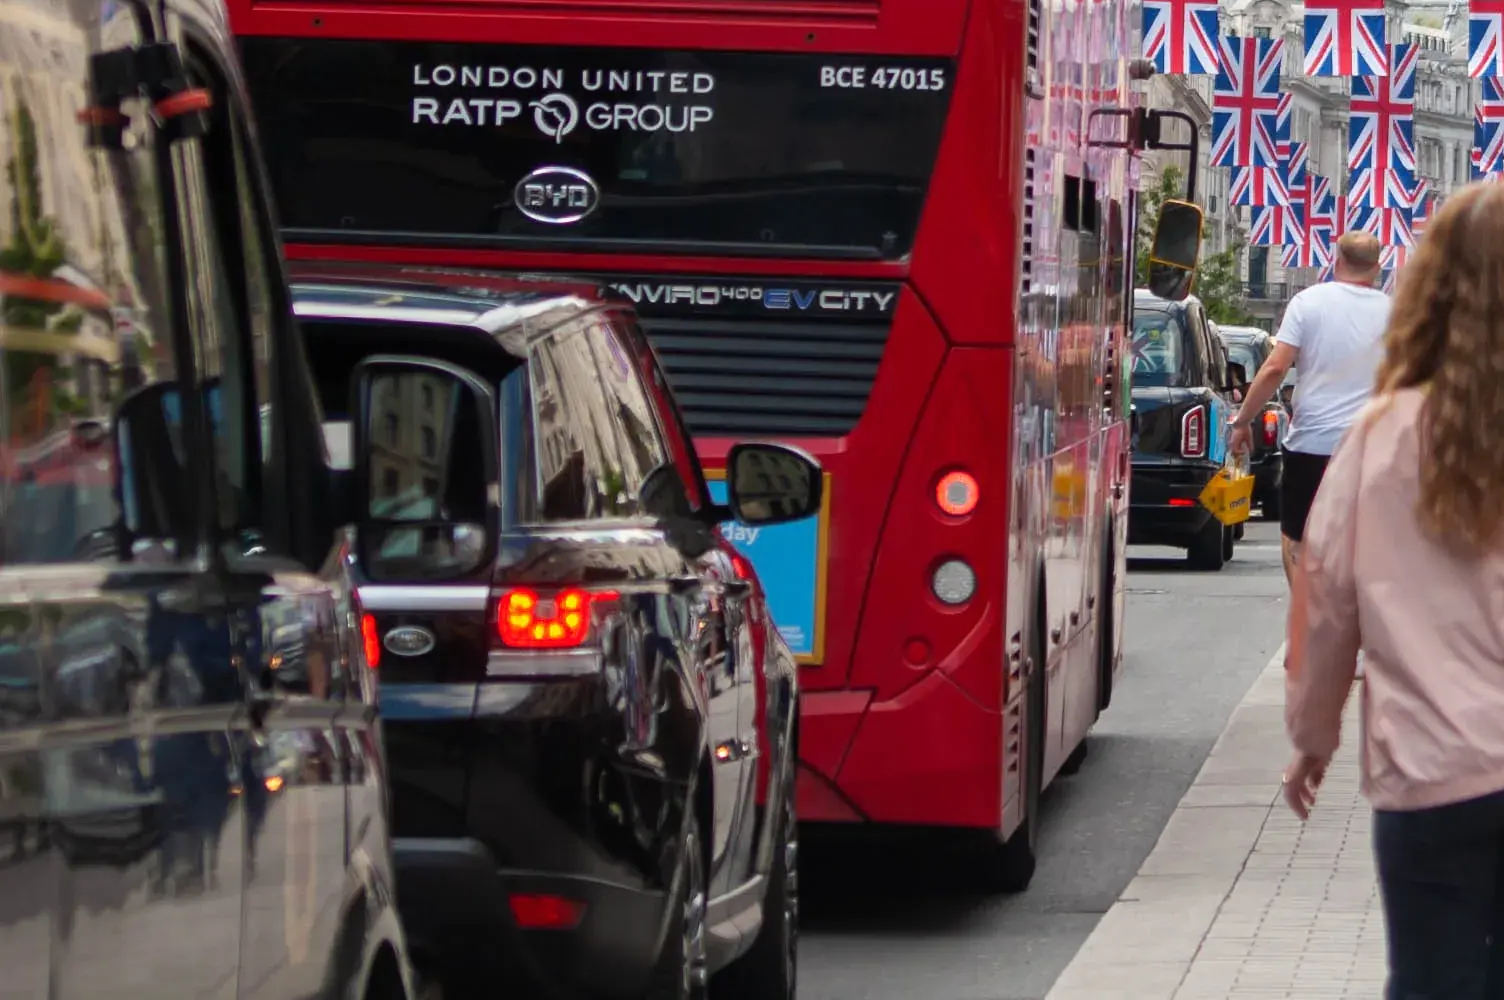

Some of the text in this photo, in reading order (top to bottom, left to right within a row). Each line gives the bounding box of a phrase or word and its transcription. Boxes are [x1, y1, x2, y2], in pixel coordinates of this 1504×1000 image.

[413, 64, 714, 94] LONDON UNITED
[820, 66, 944, 90] BCE 47015
[412, 97, 714, 132] RATP GROUP
[525, 184, 587, 207] BYD
